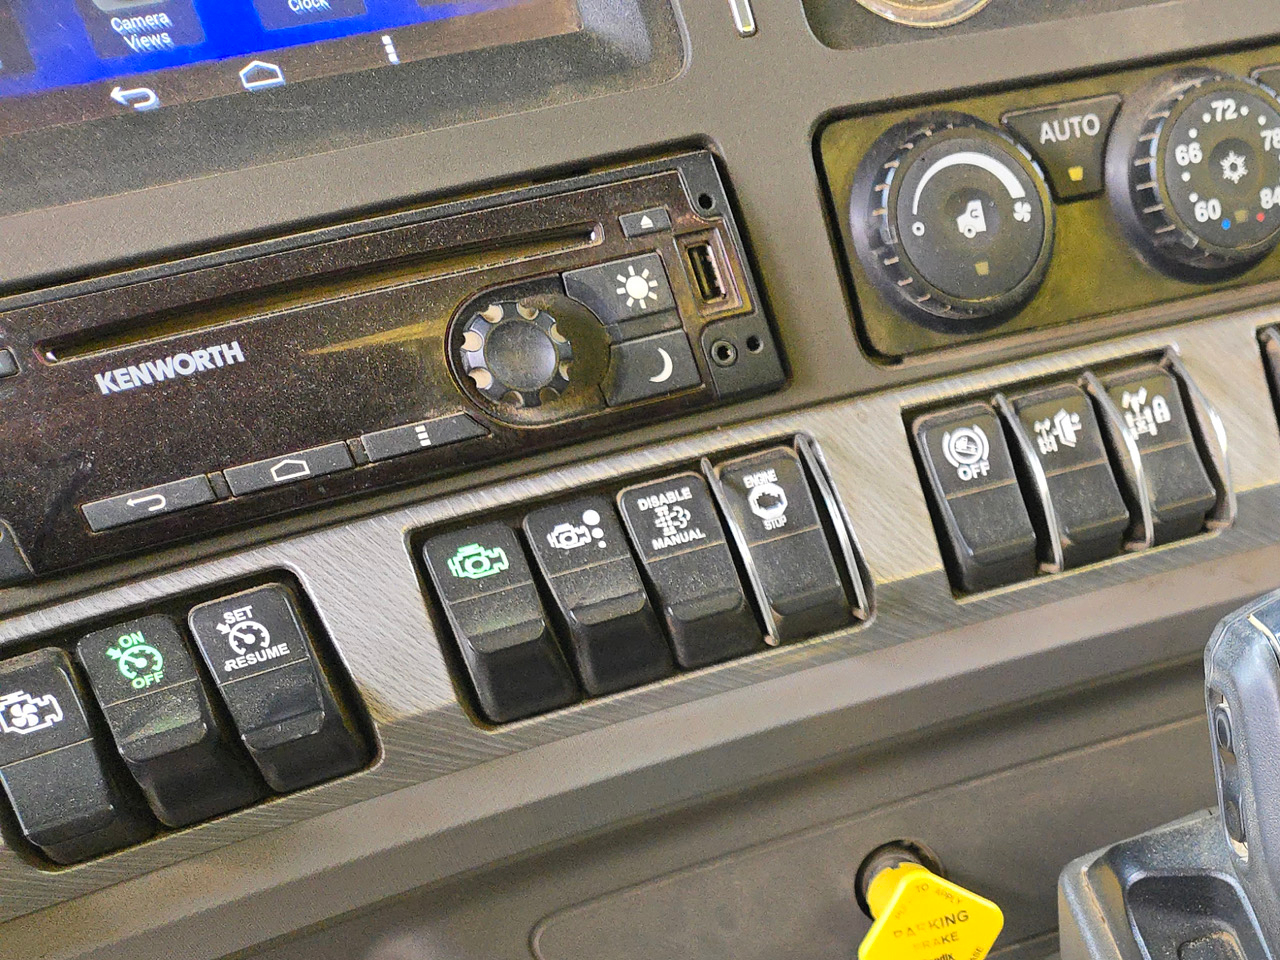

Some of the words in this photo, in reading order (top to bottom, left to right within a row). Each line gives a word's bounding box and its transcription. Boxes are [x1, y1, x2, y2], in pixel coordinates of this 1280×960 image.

[110, 12, 171, 33] Camera
[124, 30, 174, 52] Views
[1211, 98, 1238, 122] 72
[1040, 113, 1100, 145] AUTO
[1175, 142, 1203, 166] 66
[1194, 198, 1222, 222] 60
[94, 341, 246, 395] KENWORTH
[743, 468, 778, 489] ENGINE
[957, 460, 991, 481] OFF
[637, 487, 692, 511] DISABLE
[763, 515, 788, 531] STOP
[652, 528, 706, 550] MANUAL
[223, 605, 254, 624] SET
[118, 631, 145, 647] ON
[224, 643, 290, 672] RESUME
[131, 670, 164, 690] OFF
